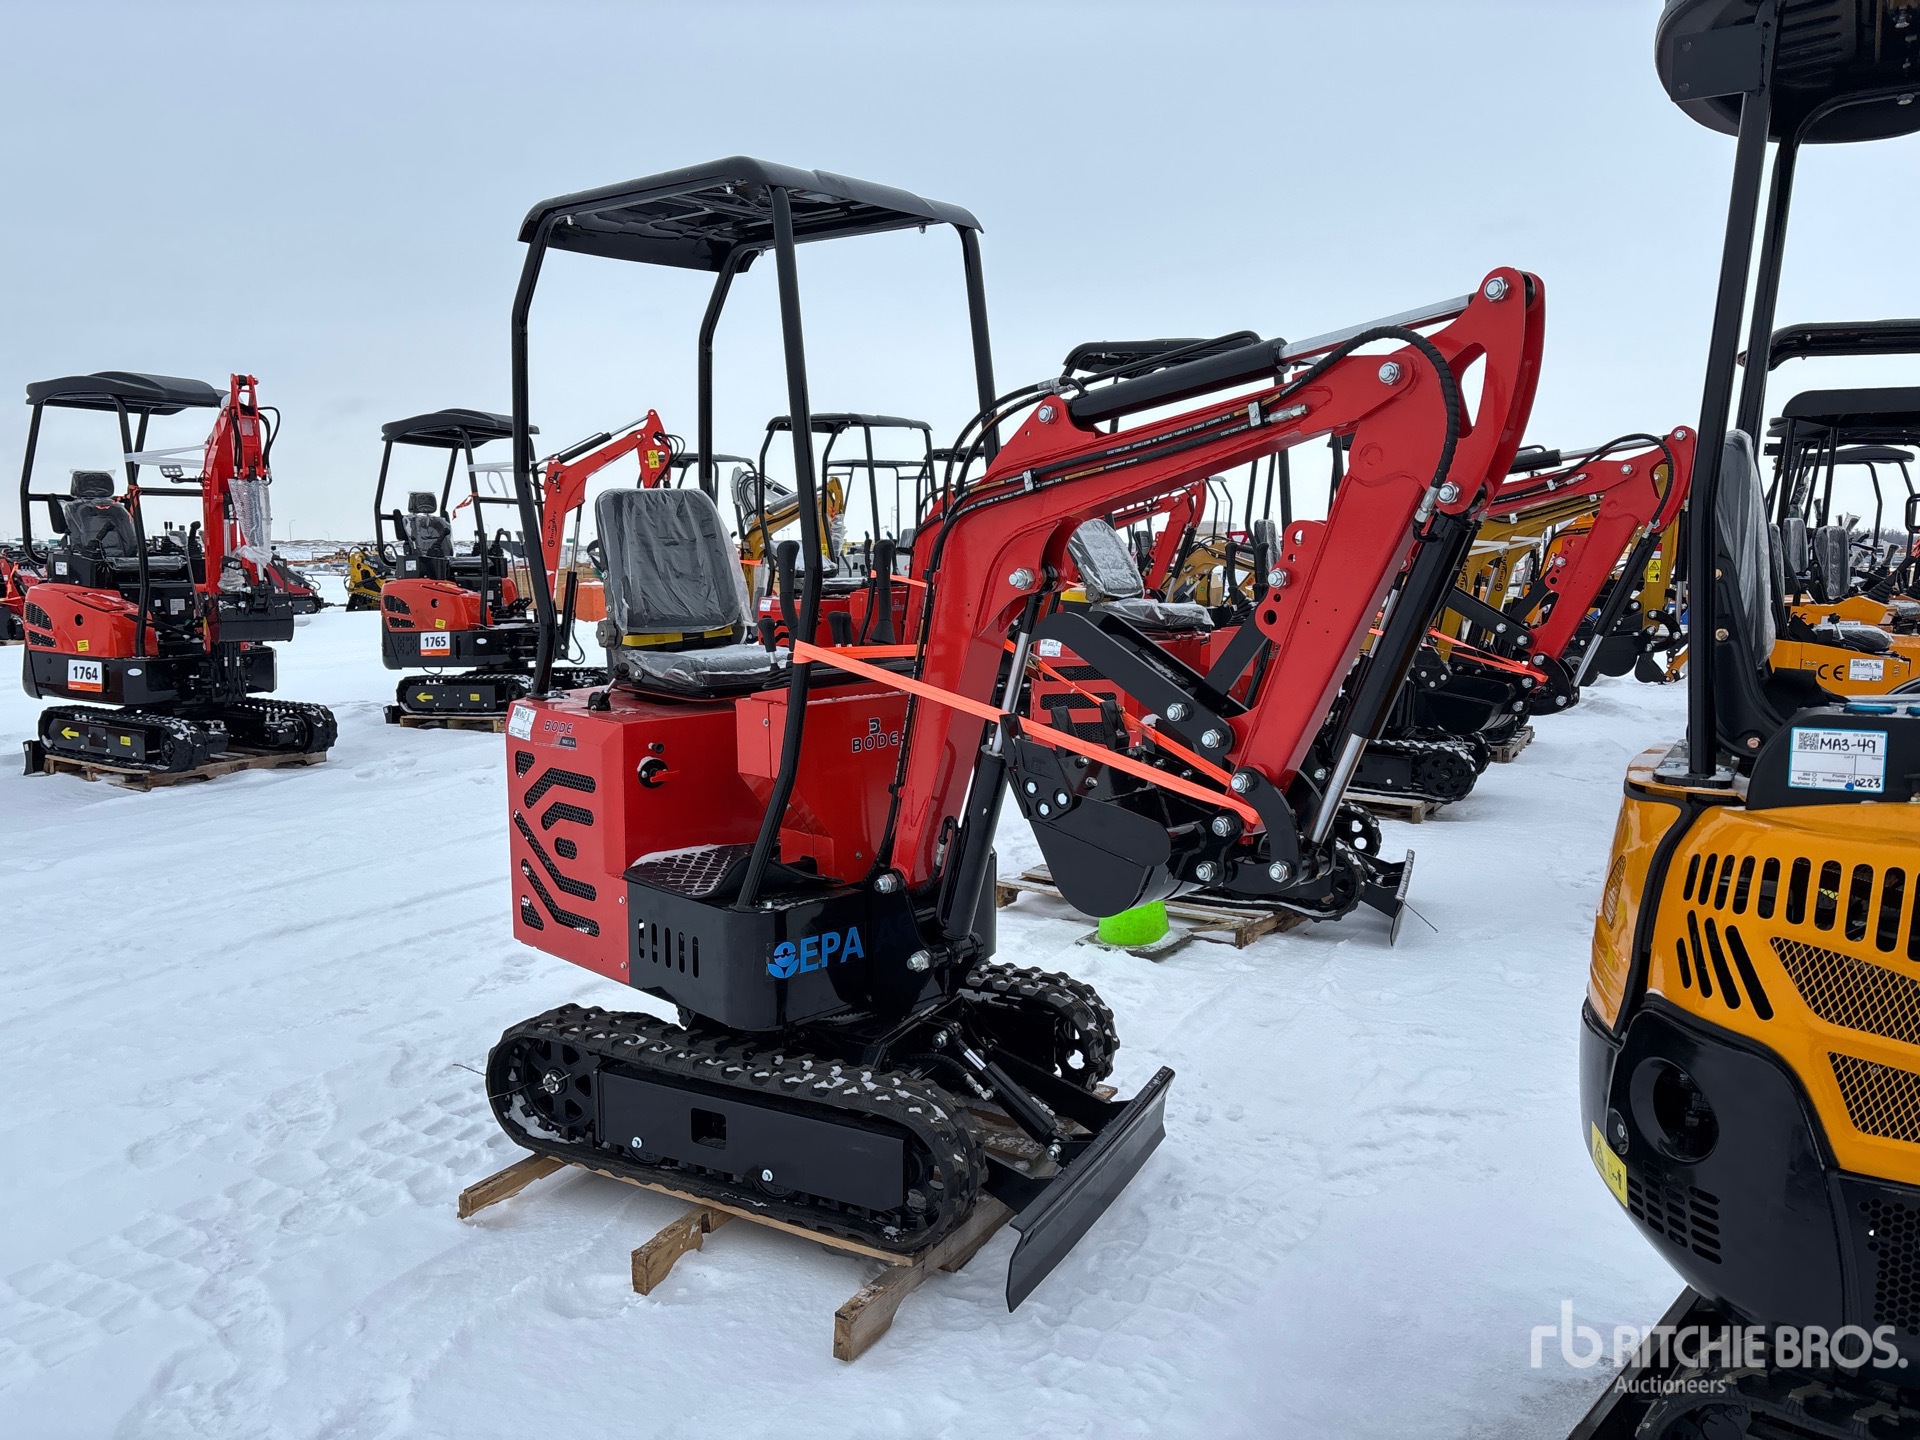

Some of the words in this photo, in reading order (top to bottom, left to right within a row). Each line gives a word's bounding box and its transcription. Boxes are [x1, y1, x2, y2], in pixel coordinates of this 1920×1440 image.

[424, 636, 446, 648] 1765
[73, 665, 98, 681] 1764
[1817, 663, 1845, 681] CE
[544, 720, 573, 734] BODE
[852, 731, 899, 753] BODE
[1819, 738, 1876, 754] MA3-49
[1854, 778, 1881, 788] 0223
[799, 926, 865, 974] EPA
